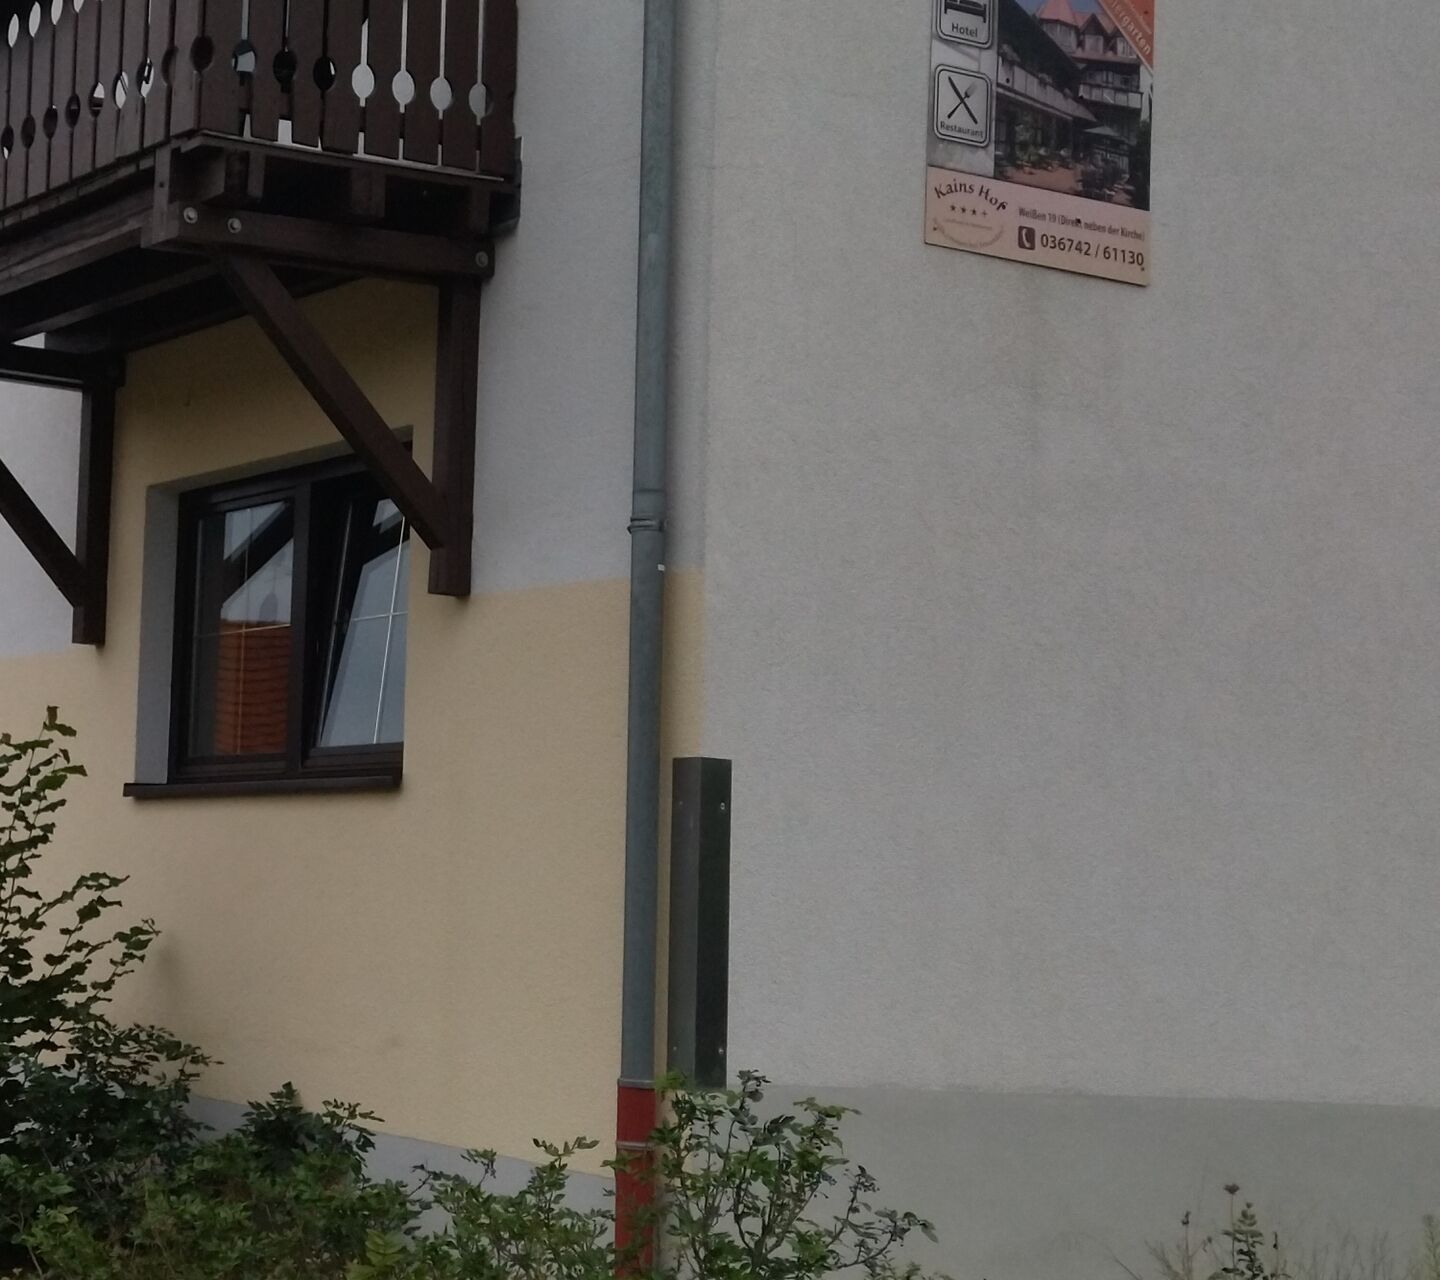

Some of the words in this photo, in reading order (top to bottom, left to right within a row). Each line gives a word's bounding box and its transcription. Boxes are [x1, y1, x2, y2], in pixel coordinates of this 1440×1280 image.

[951, 23, 978, 38] Hotel
[940, 121, 983, 138] Restaurant
[934, 178, 974, 198] Kains
[978, 185, 1008, 211] Hof
[1107, 226, 1120, 235] der
[1040, 234, 1091, 256] 036742
[1095, 243, 1100, 258] /
[1103, 246, 1144, 266] 61130
